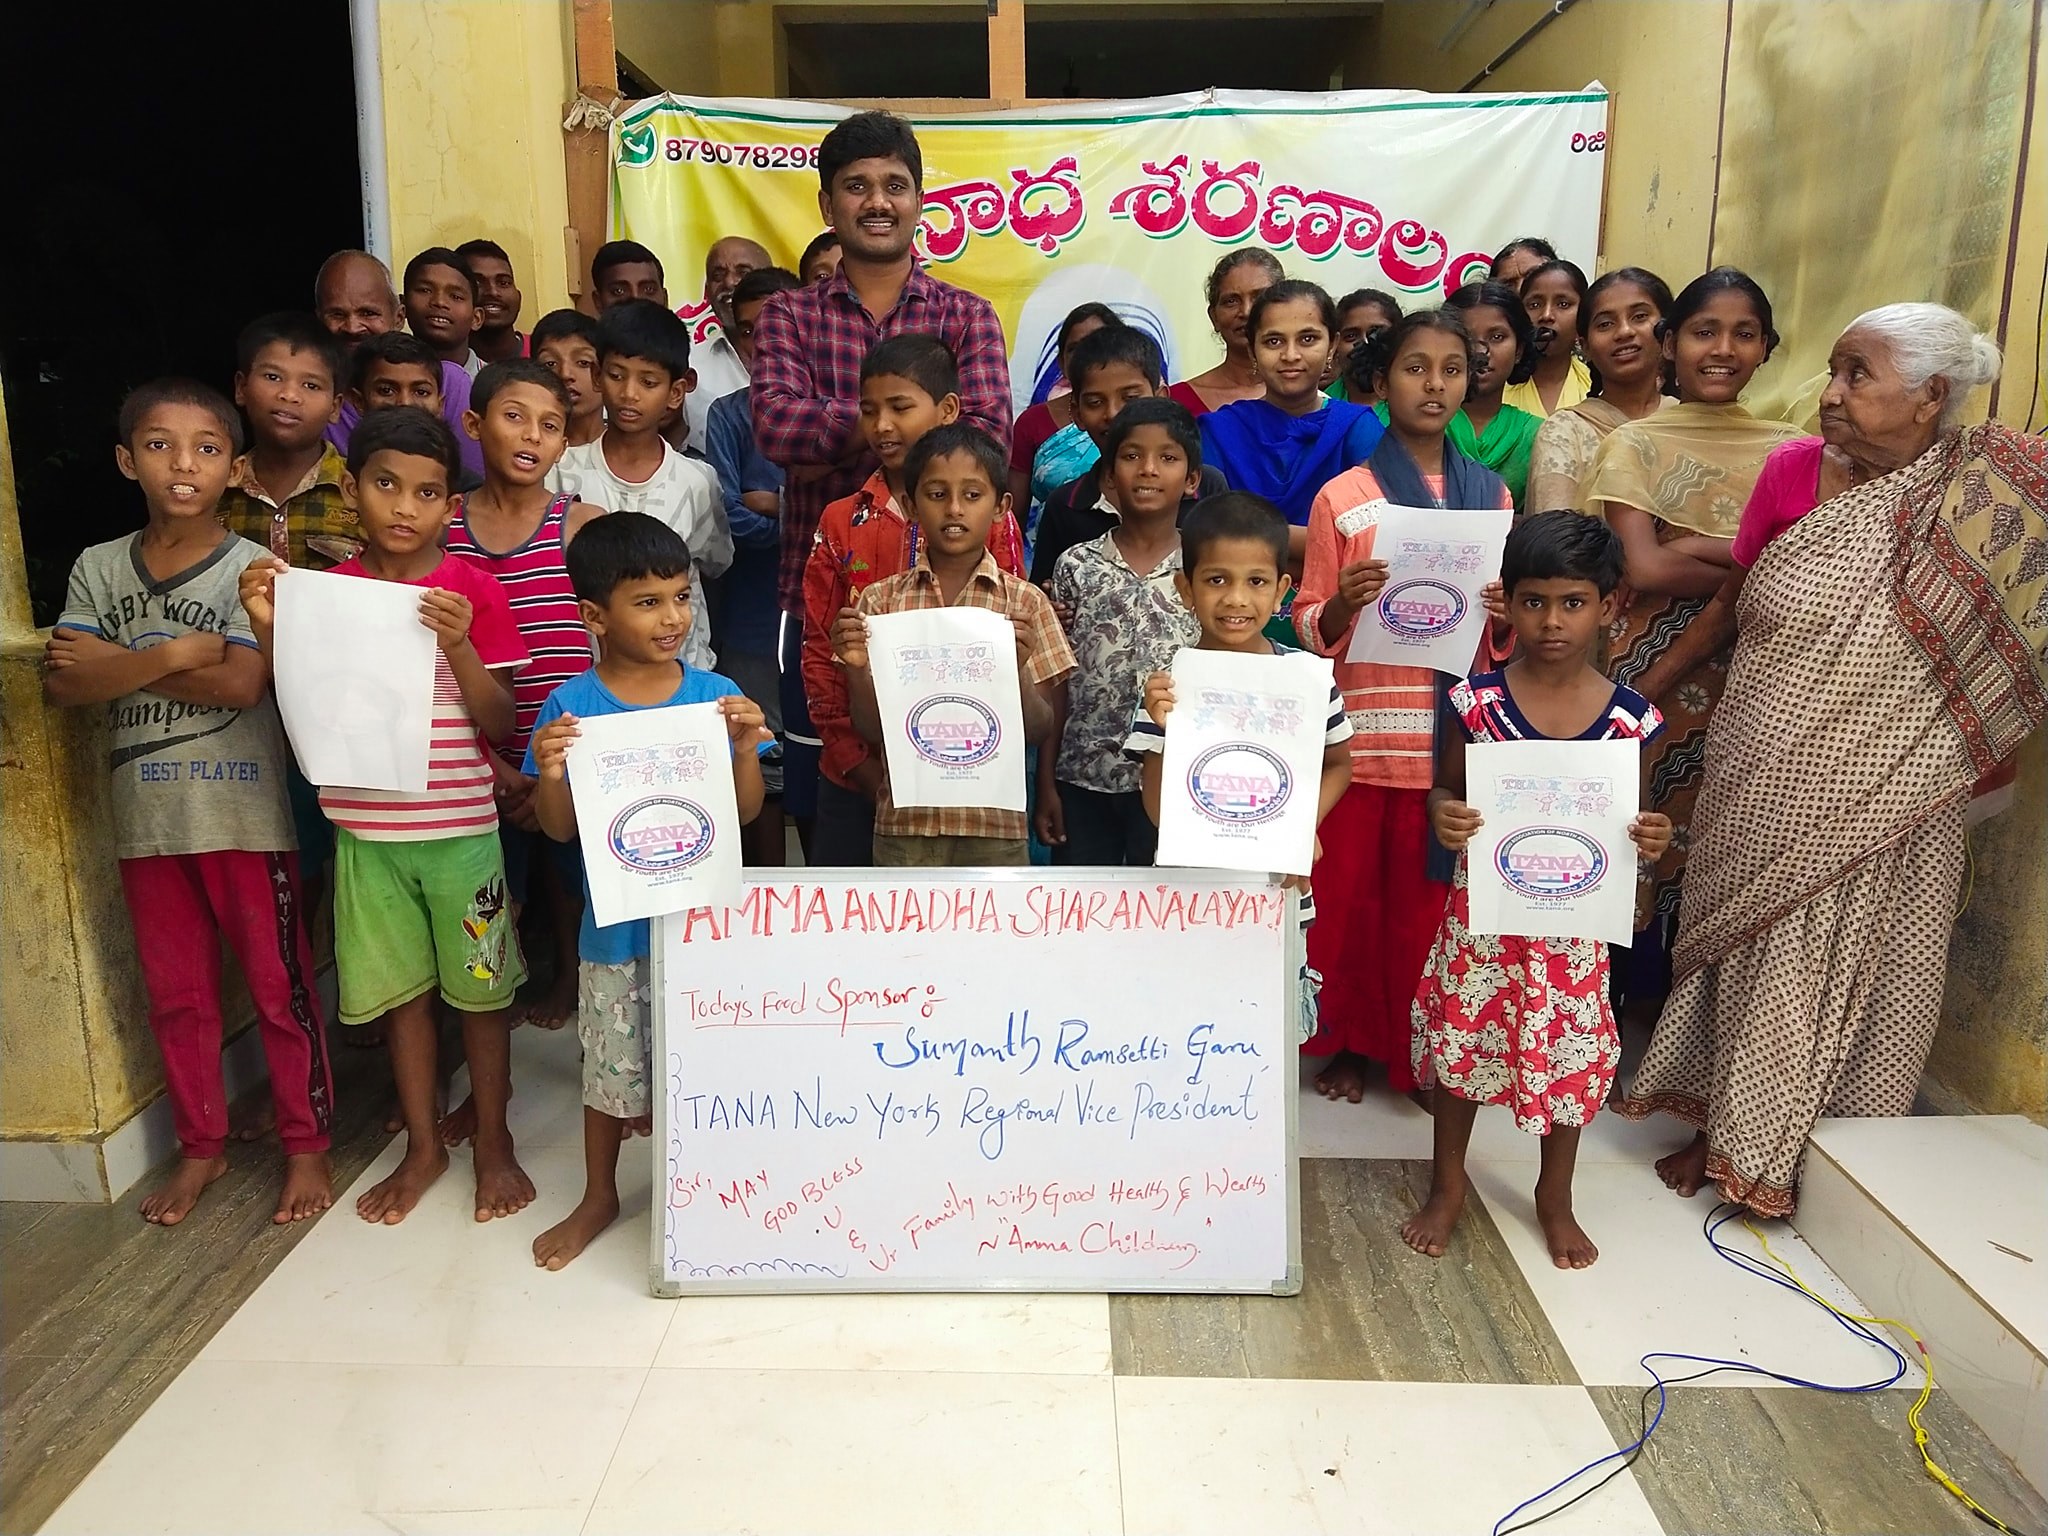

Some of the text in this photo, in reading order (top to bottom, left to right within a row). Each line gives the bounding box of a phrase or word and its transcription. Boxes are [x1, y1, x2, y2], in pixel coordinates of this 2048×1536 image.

[665, 138, 820, 168] 879078298
[910, 156, 1084, 262] నాధ
[1402, 542, 1481, 554] THAK OU
[1391, 600, 1451, 617] TANA
[900, 646, 986, 661] THAK OU
[919, 720, 988, 738] TANA
[141, 761, 258, 781] BEST PLAYER
[1202, 772, 1277, 794] TANA
[622, 820, 701, 848] TANA
[1510, 853, 1592, 871] TANA
[1502, 881, 1514, 892] Our
[1515, 891, 1538, 901] Youth
[683, 884, 1285, 943] AMMA ANADHA SHARANALAYAM
[762, 981, 806, 1019] Food
[1054, 1019, 1168, 1071] Ramsetti
[683, 1074, 1258, 1160] TANA New York Regional Vice President
[719, 1169, 769, 1218] MAY
[801, 1157, 863, 1203] BLESS
[1109, 1179, 1169, 1211] Health
[1205, 1168, 1267, 1197] Wealth
[987, 1184, 1037, 1214] with
[1042, 1182, 1096, 1217] Good
[764, 1201, 798, 1233] GOD
[824, 1205, 843, 1229] U
[903, 1182, 974, 1249] Family
